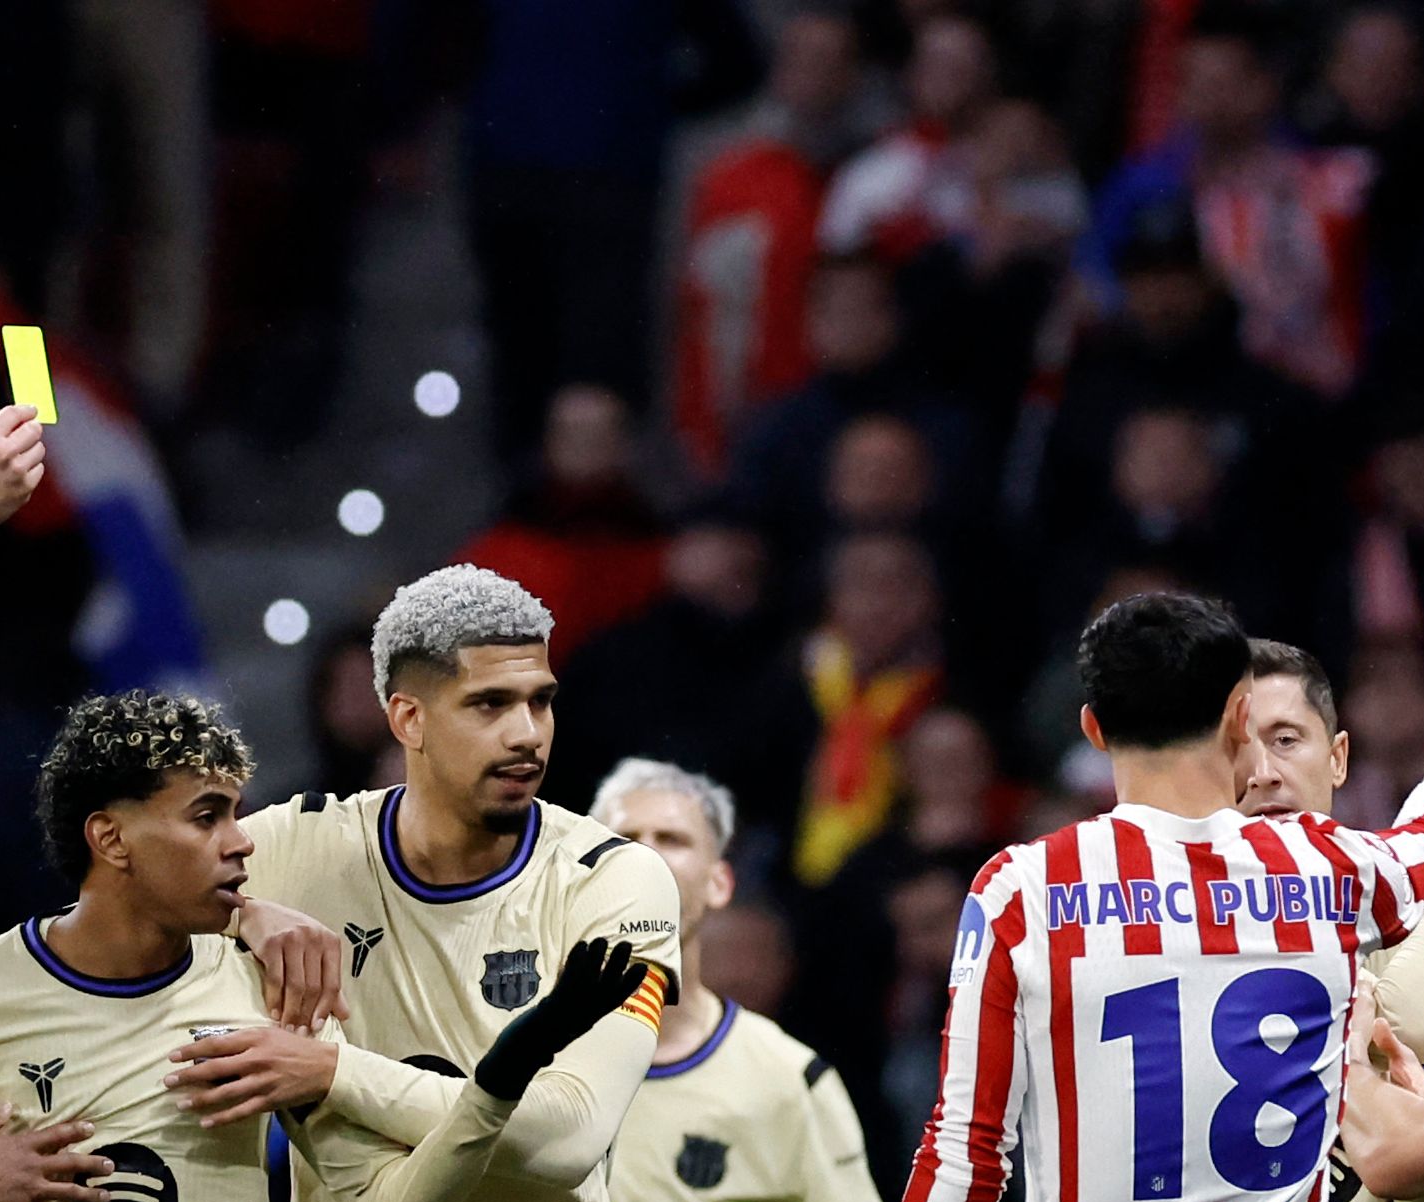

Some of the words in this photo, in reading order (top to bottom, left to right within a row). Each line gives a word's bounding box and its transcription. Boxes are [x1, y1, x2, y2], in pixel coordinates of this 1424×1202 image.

[1048, 882, 1193, 929] MARC
[1209, 875, 1358, 925] PUBILL
[1100, 967, 1332, 1201] 18
